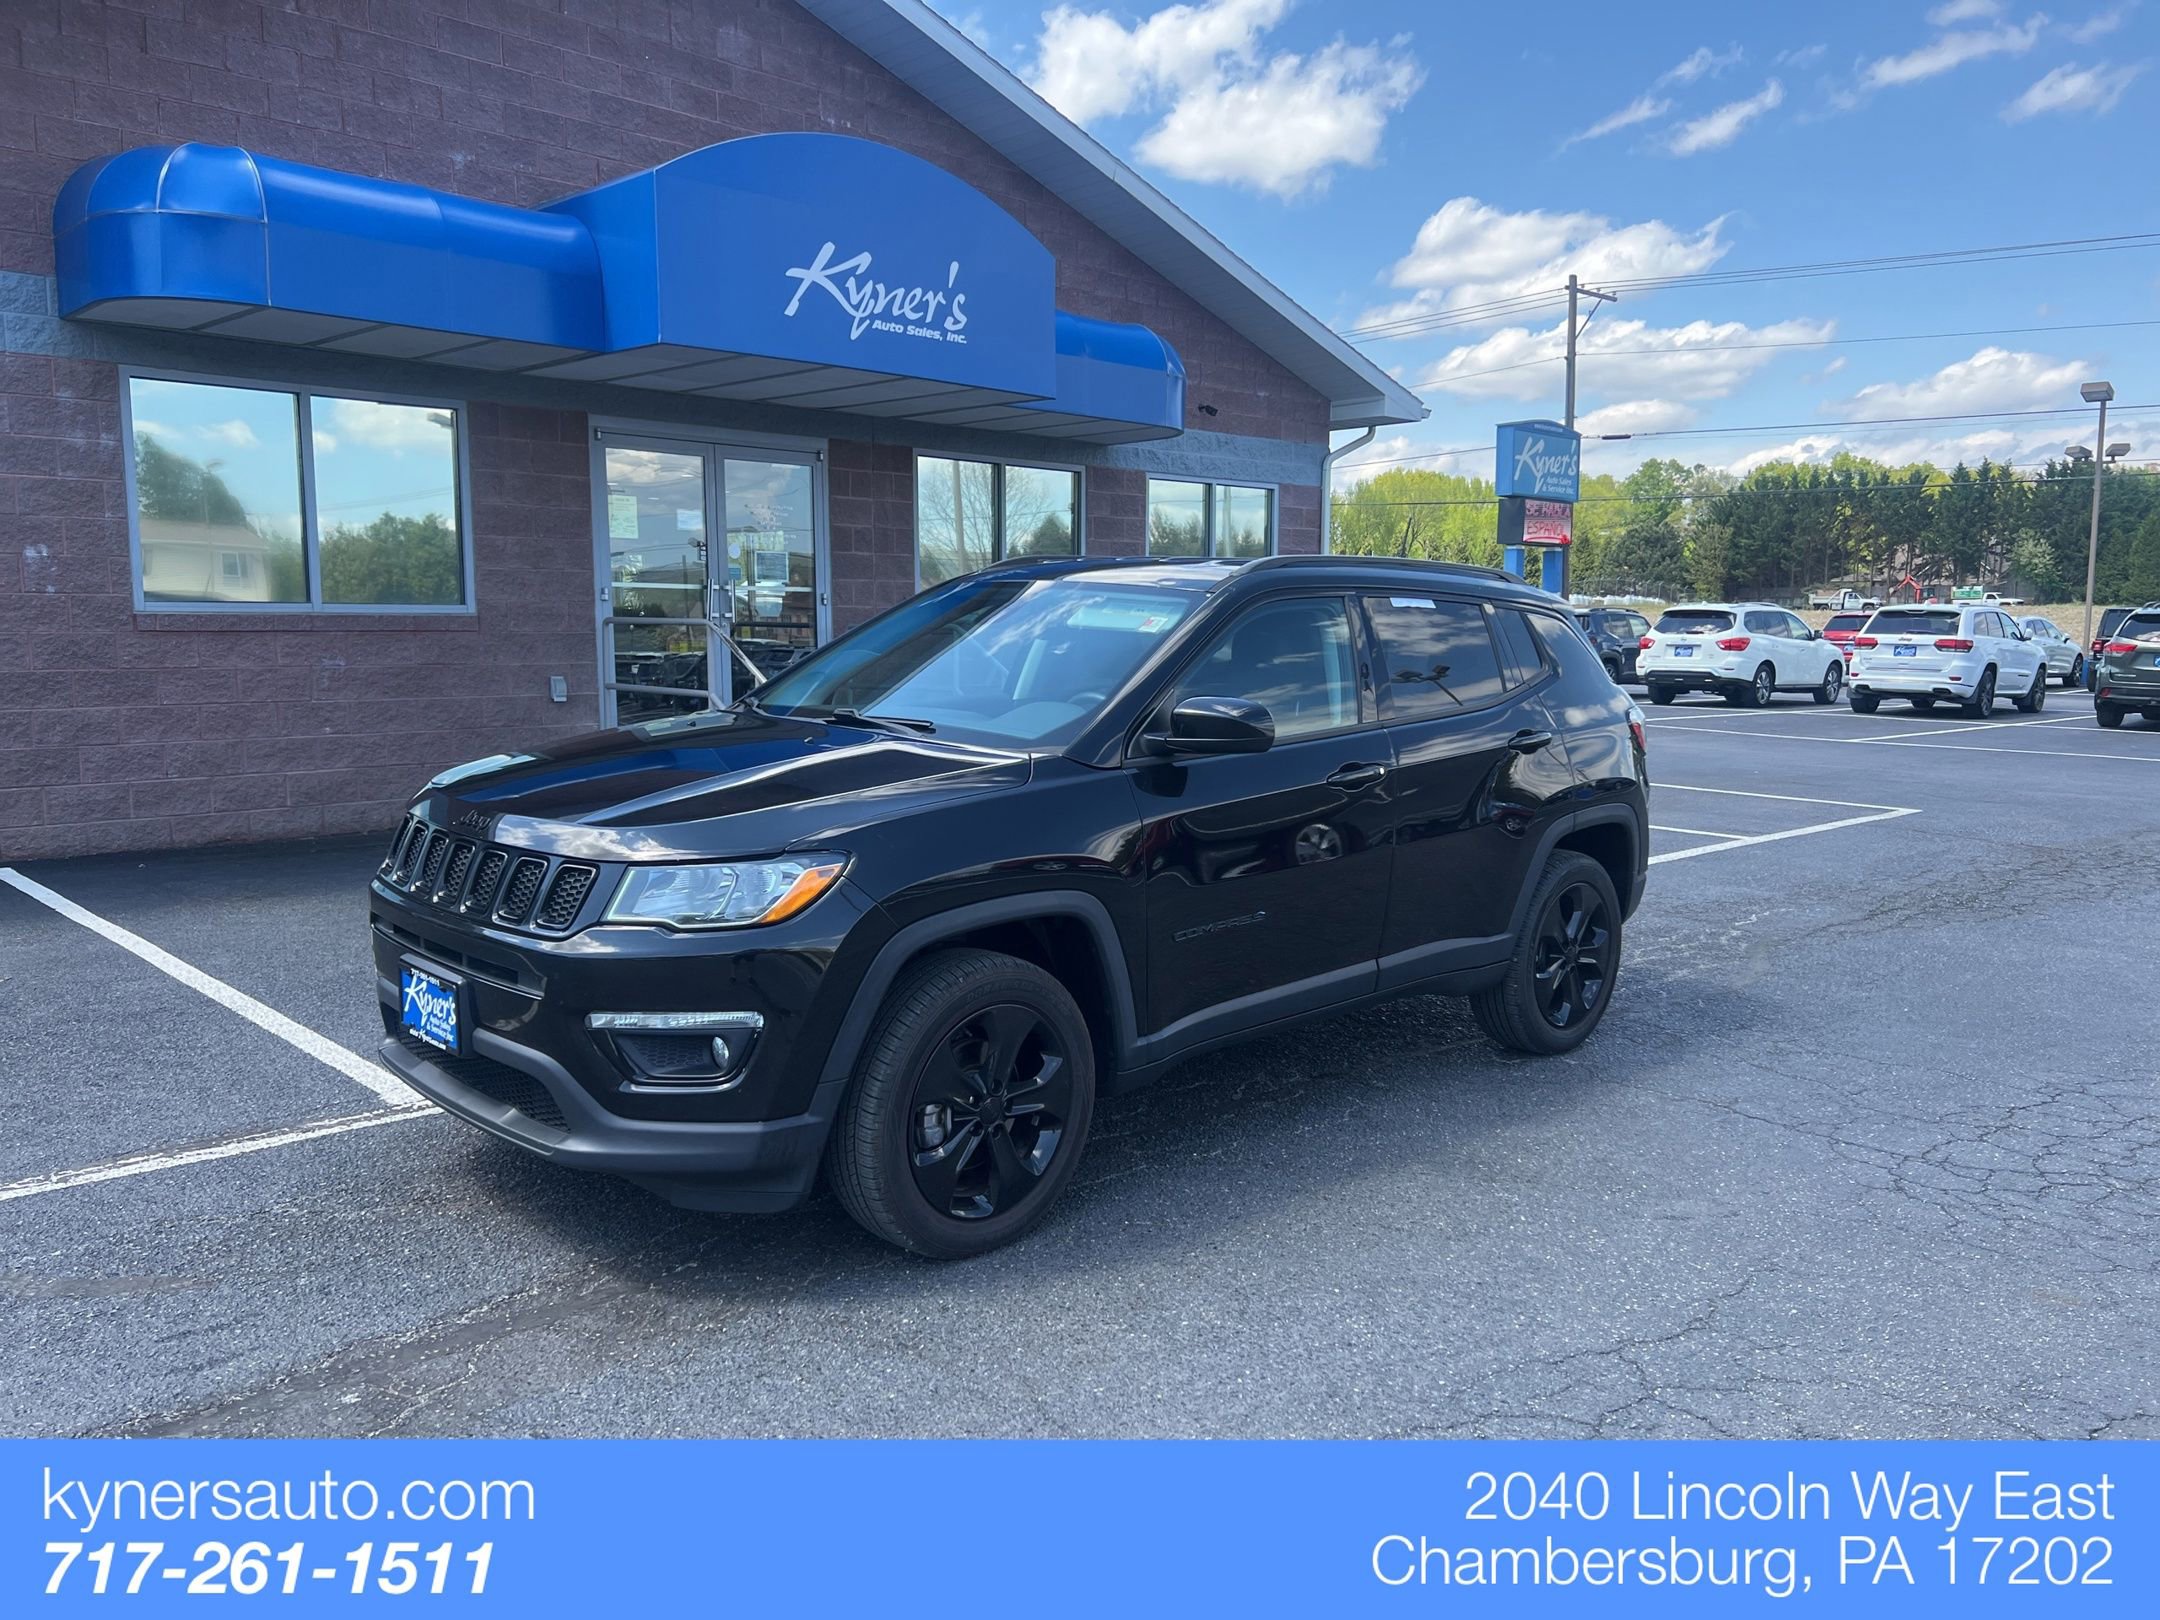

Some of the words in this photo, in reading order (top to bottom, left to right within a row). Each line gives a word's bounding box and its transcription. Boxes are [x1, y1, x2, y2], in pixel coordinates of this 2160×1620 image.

[784, 241, 968, 340] Kyner's
[871, 319, 904, 334] Auto
[906, 325, 943, 341] Sales,
[945, 331, 968, 345] Inc.
[1514, 436, 1577, 494] Kyner's
[404, 974, 456, 1026] Kyner's
